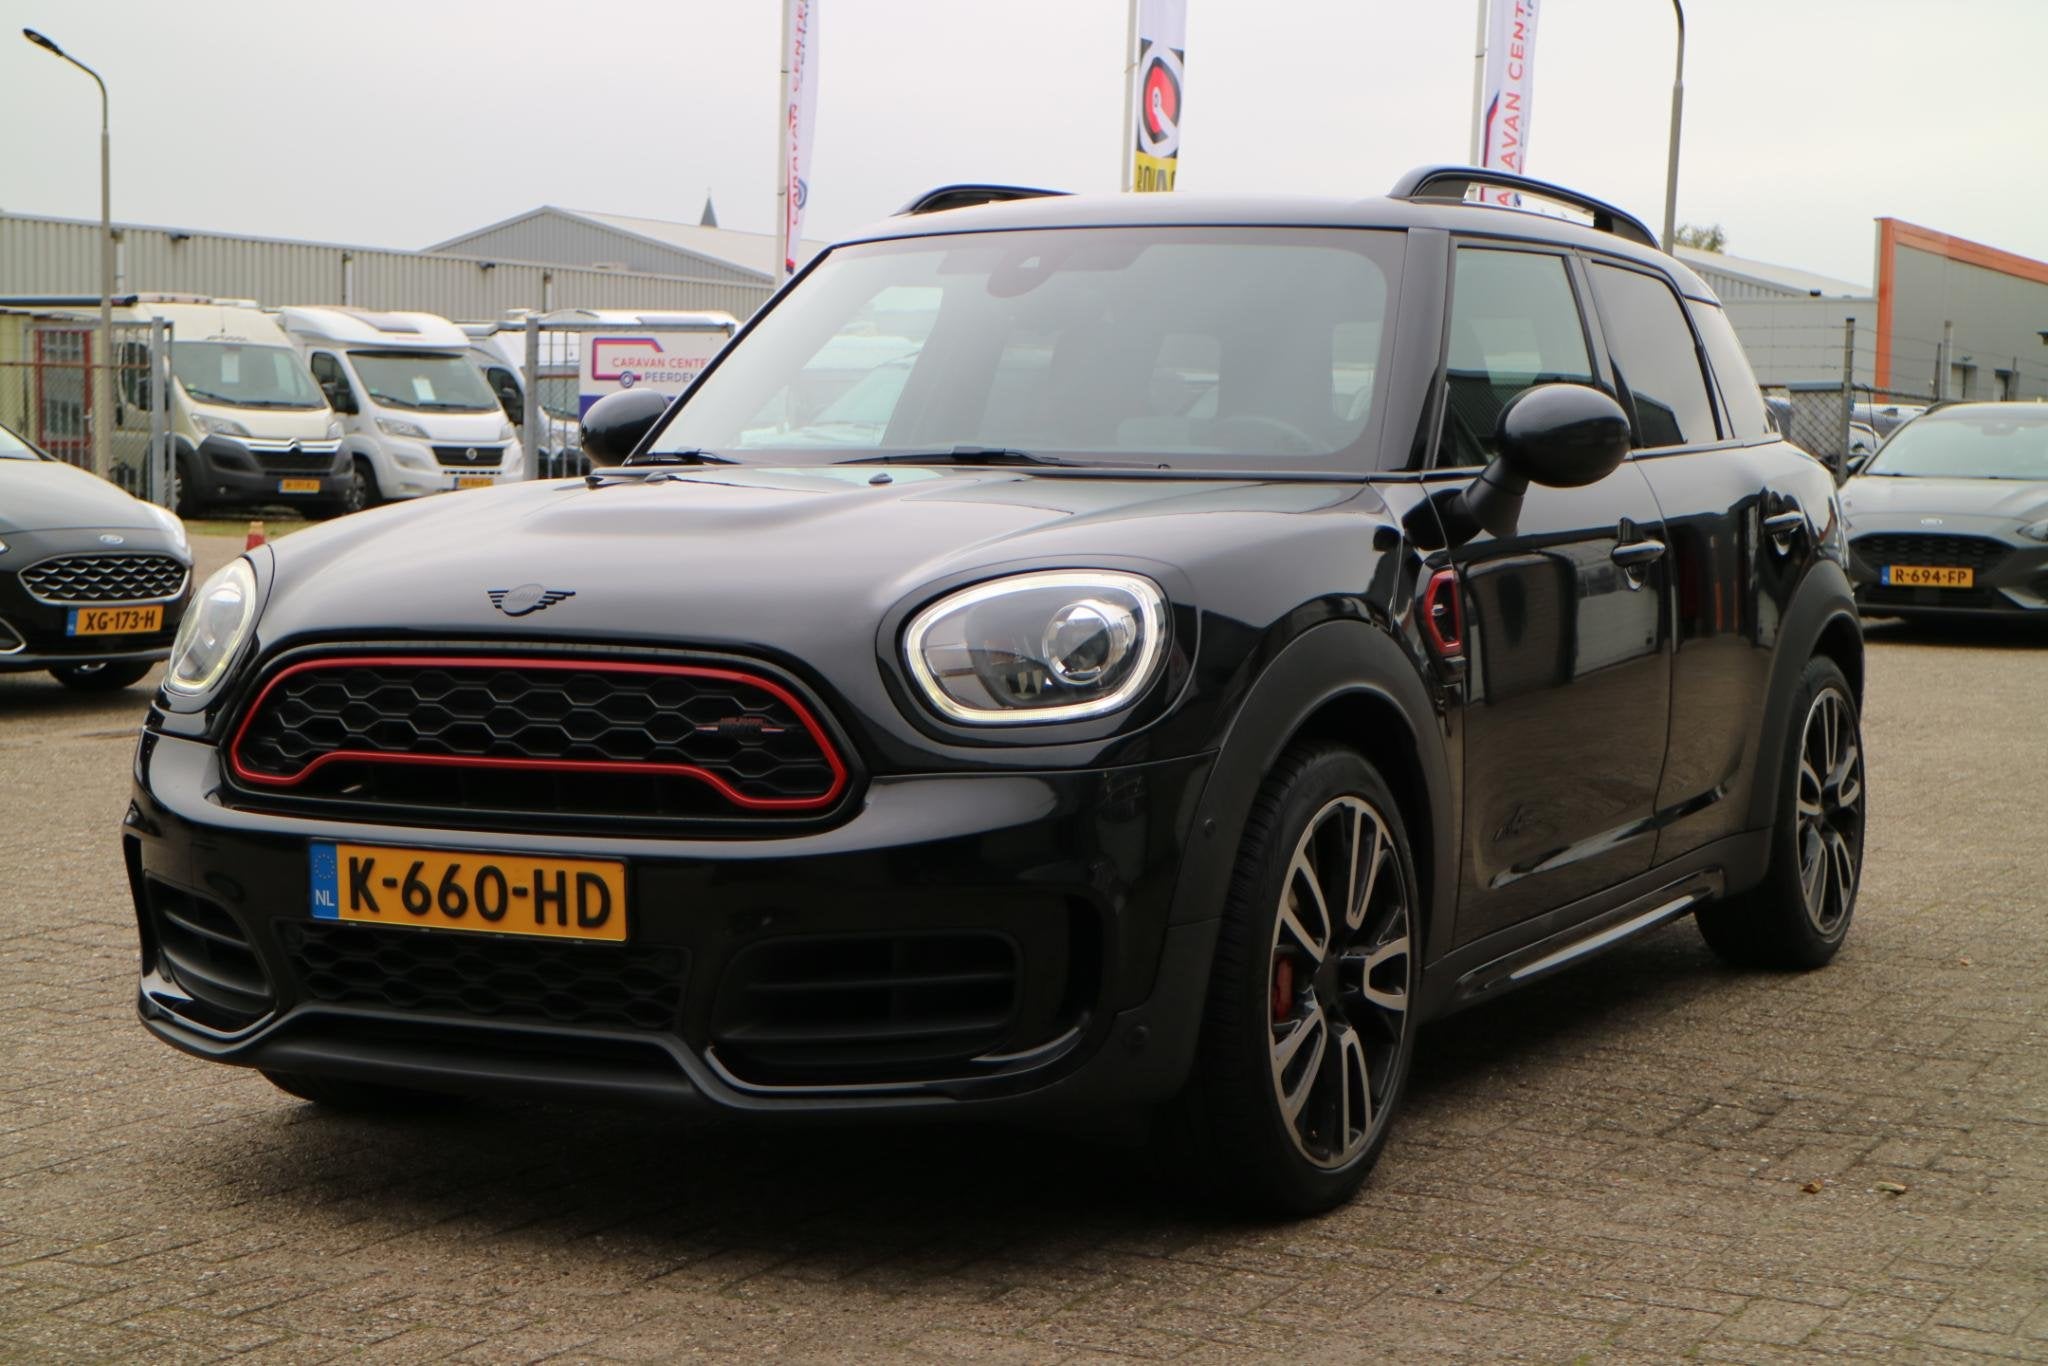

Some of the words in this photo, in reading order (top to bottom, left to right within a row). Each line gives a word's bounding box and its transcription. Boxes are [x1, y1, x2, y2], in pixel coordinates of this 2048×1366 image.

[1508, 0, 1524, 80] CENT
[1496, 92, 1521, 206] AAVAN
[612, 357, 665, 368] CARAVAN
[669, 357, 709, 369] CENTE
[85, 610, 156, 631] XG-173-H
[315, 889, 335, 907] NL
[348, 856, 612, 929] K-660-HD
